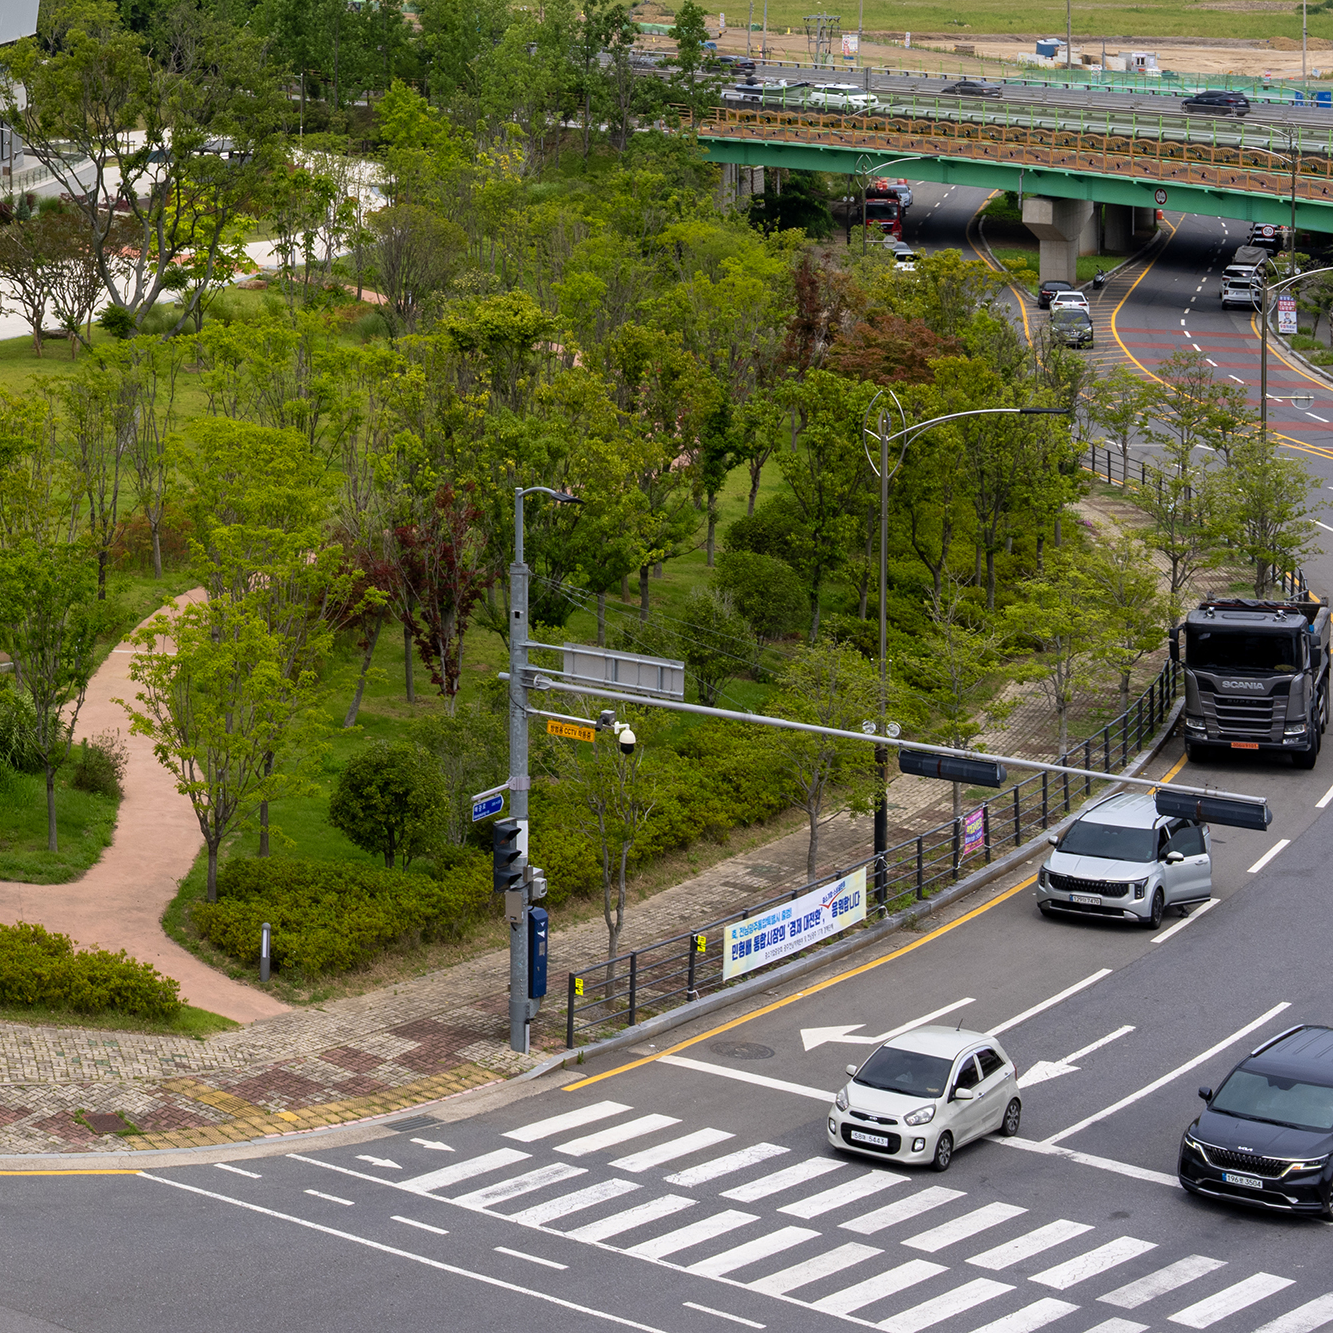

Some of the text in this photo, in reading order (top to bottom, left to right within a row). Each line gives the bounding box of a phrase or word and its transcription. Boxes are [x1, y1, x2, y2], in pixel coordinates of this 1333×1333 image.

[1222, 680, 1265, 690] SCANIA
[564, 727, 578, 736] CCTV
[753, 924, 786, 952] 통합시장의
[831, 890, 861, 918] 응원합니다
[1244, 1178, 1261, 1187] 3504
